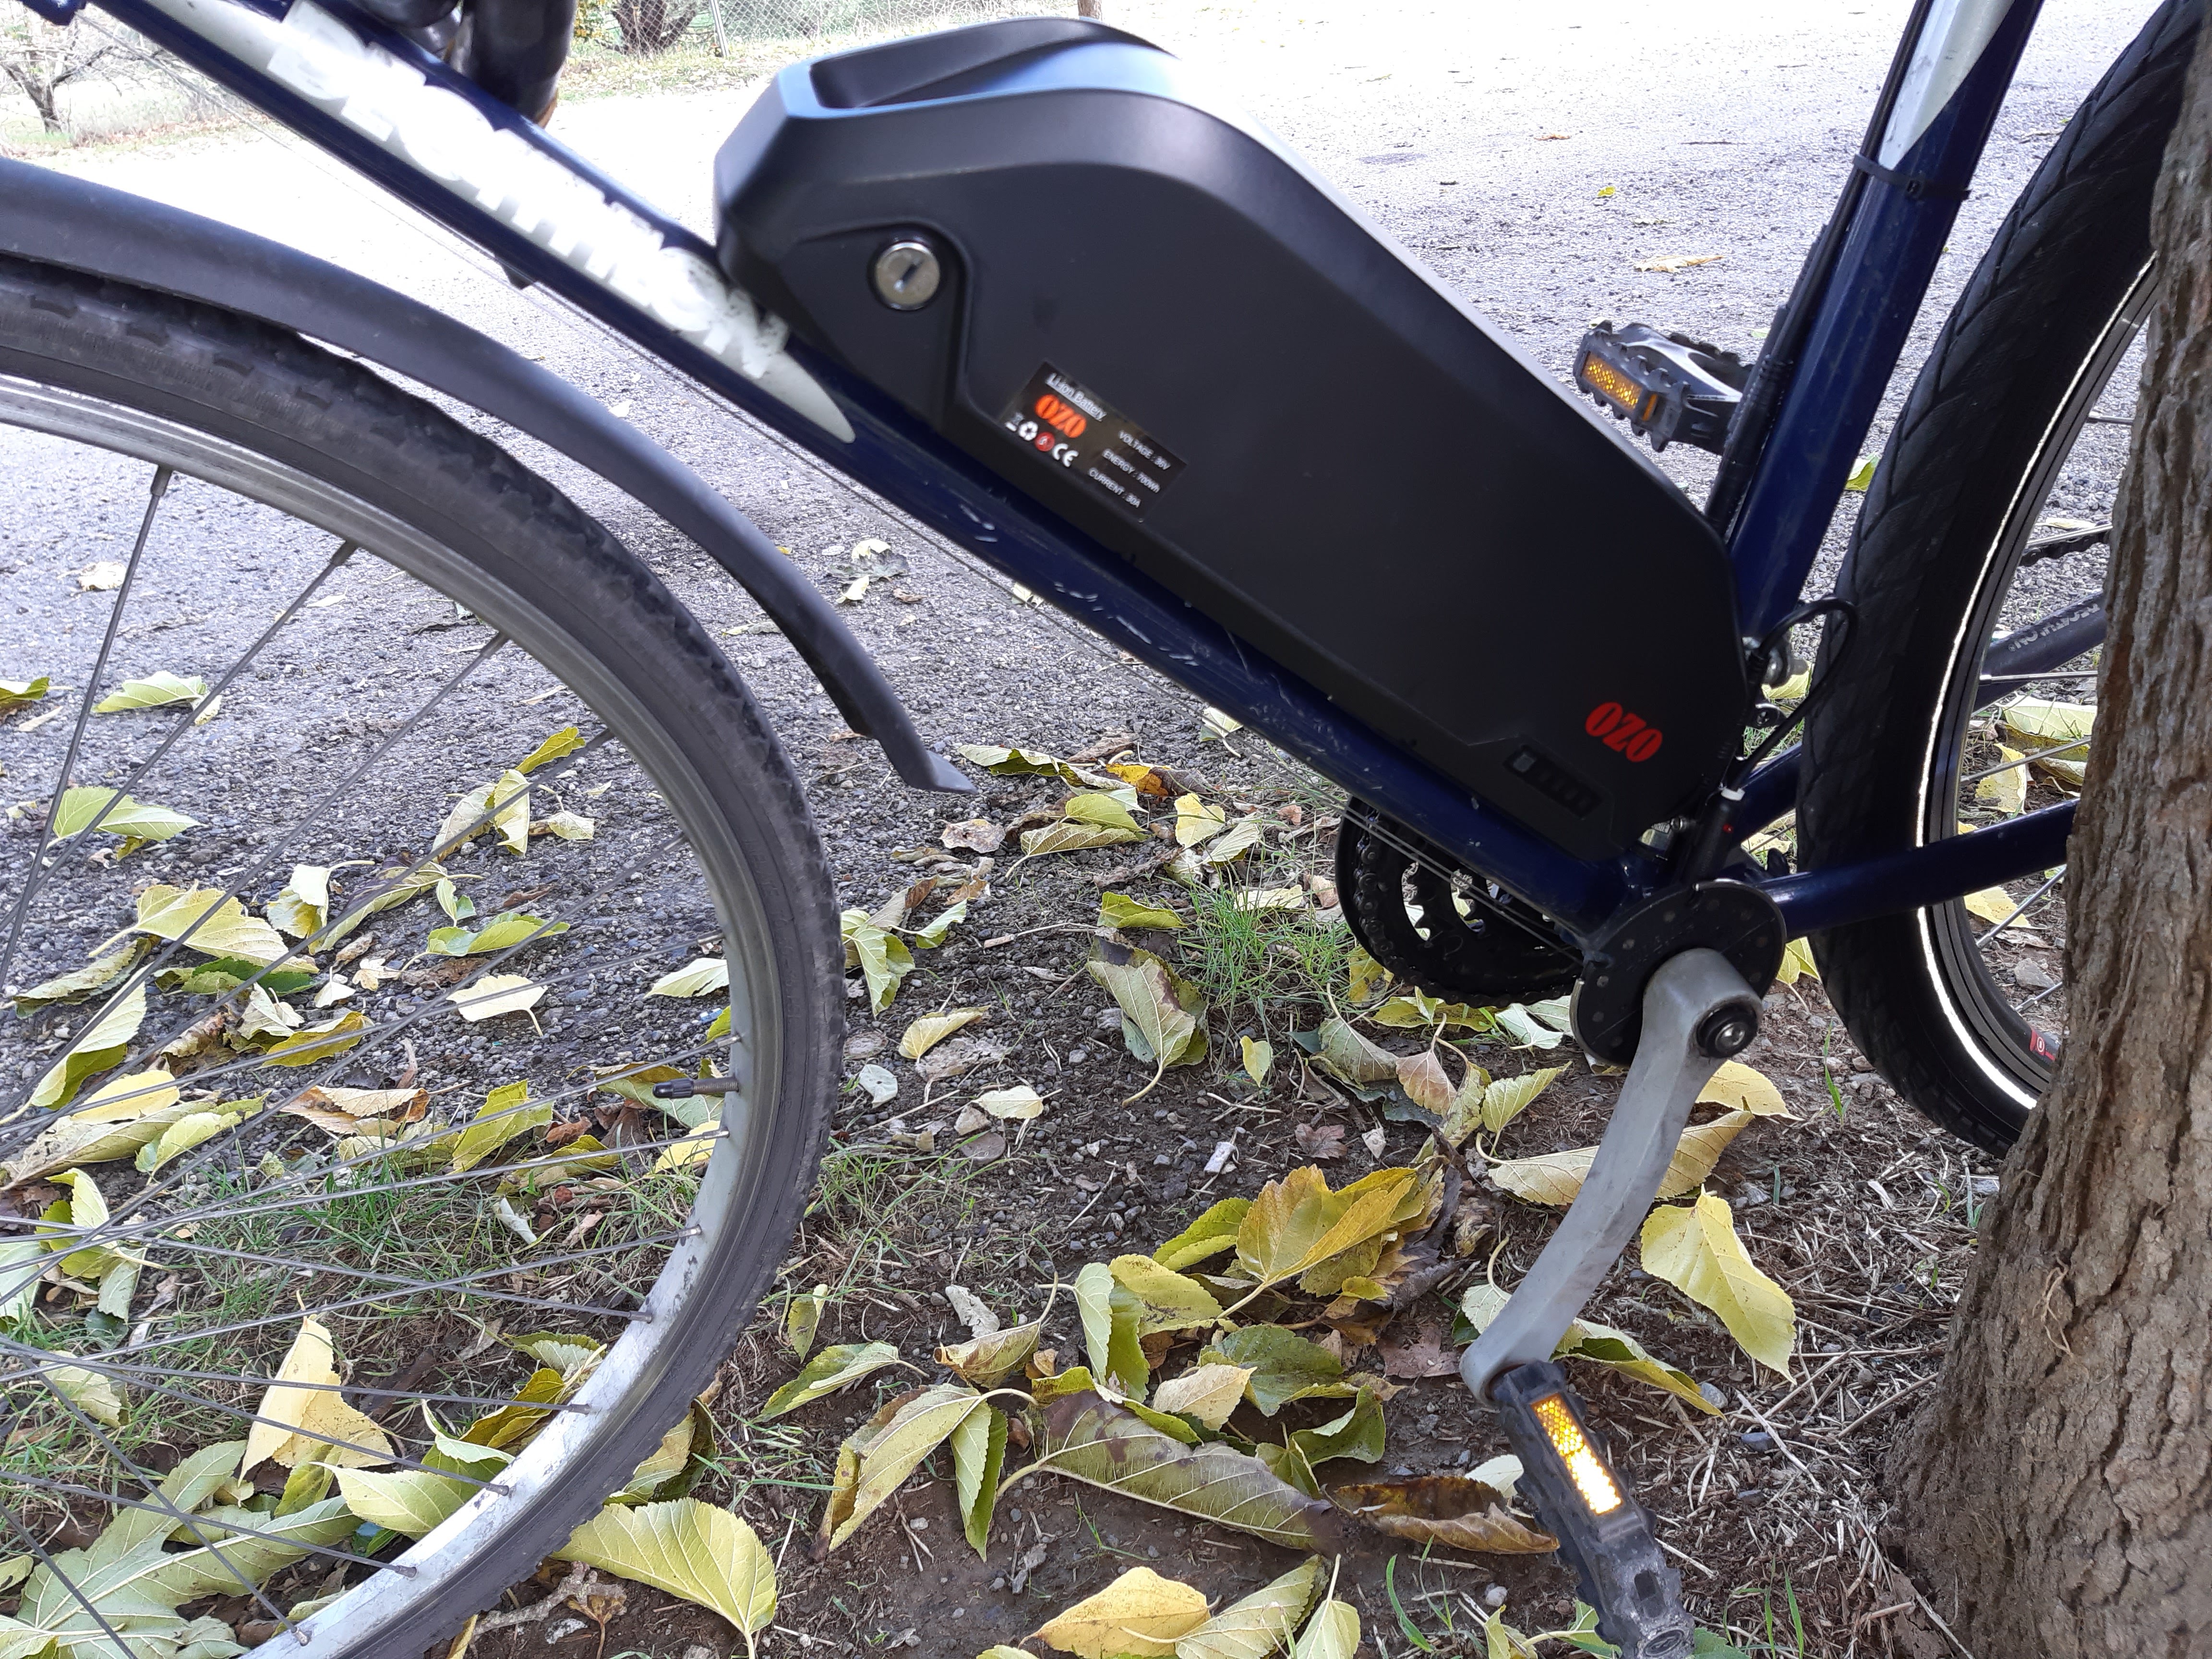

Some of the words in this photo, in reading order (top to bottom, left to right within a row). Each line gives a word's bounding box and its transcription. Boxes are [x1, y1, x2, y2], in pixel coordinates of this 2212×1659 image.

[1034, 394, 1087, 438] OZO
[1073, 391, 1107, 421] Battery
[1102, 448, 1136, 474] ENERGY
[1137, 472, 1161, 493] 700Wh
[1119, 430, 1154, 459] VOLTAGE
[1154, 456, 1171, 470] 36V
[1088, 467, 1126, 495] CURRENT
[1126, 493, 1142, 508] 30A
[1585, 701, 1663, 762] OZO
